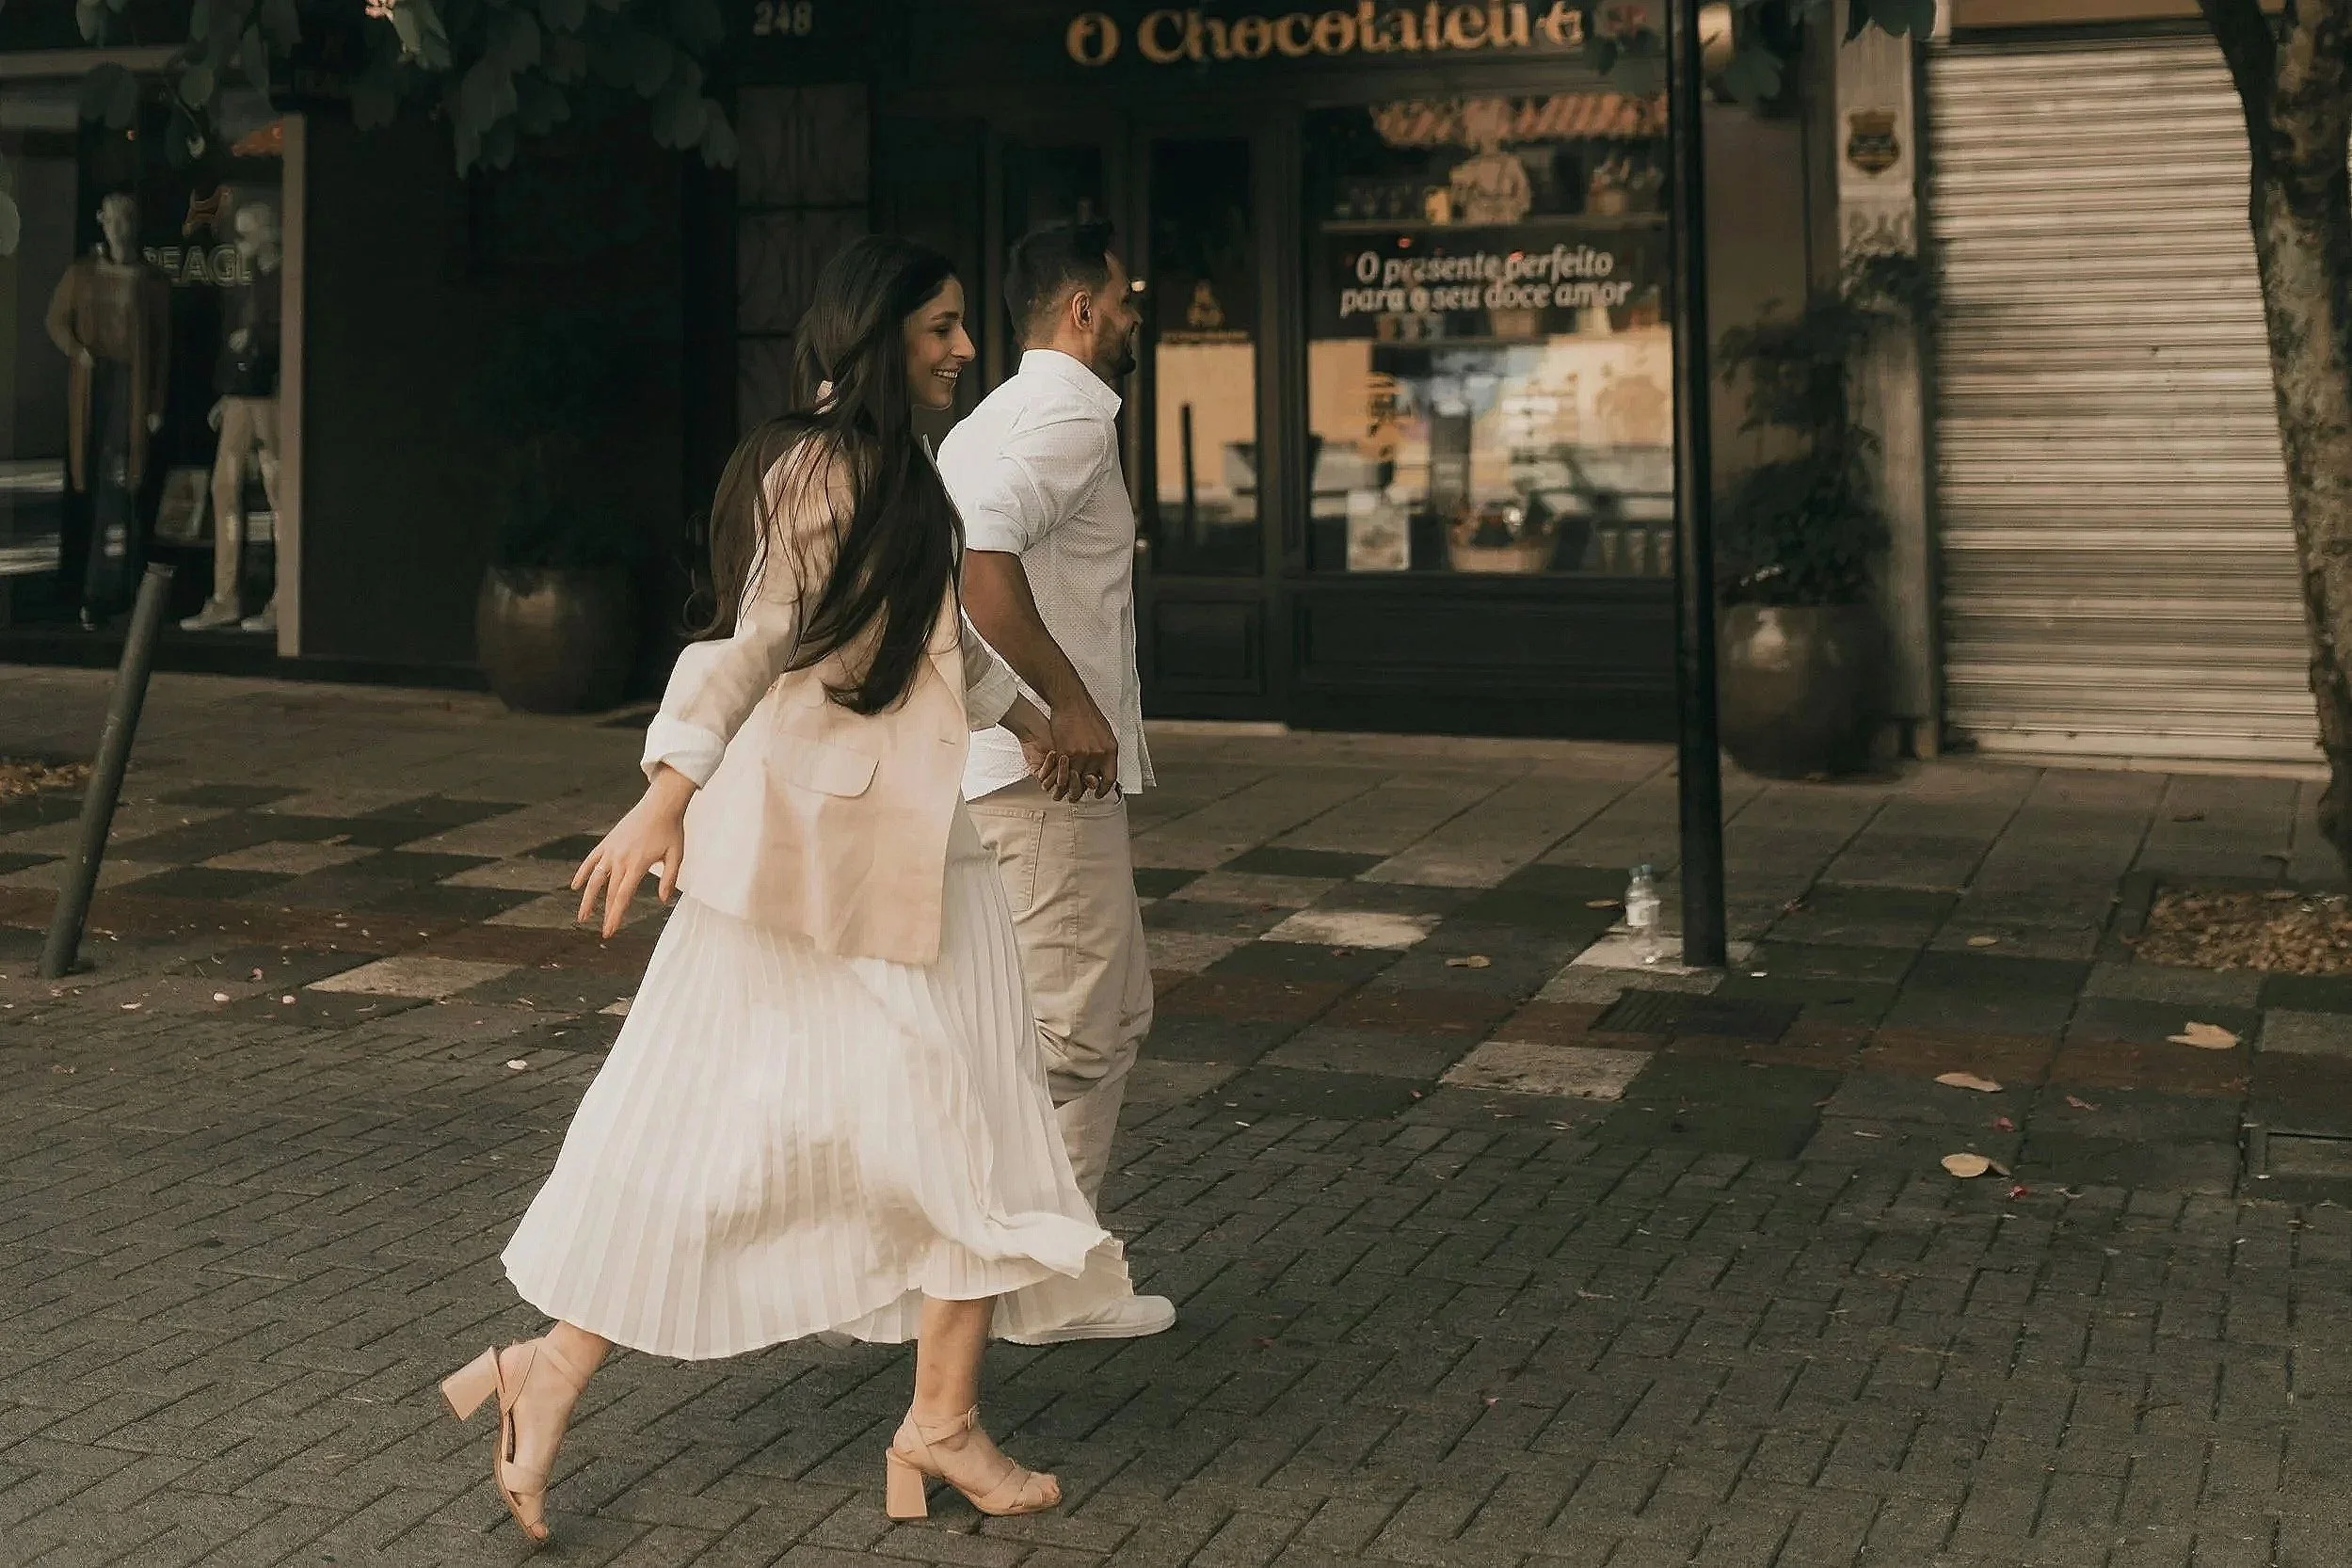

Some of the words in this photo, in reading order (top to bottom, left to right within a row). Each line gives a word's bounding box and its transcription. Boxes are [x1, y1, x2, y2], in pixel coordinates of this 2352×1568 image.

[753, 1, 812, 36] 248
[1066, 11, 1121, 66] O
[1356, 250, 1381, 283] O
[1383, 250, 1502, 287] presente
[1504, 243, 1614, 285] perfeito
[1339, 286, 1406, 318] para
[1410, 287, 1431, 312] o
[1431, 286, 1480, 310] seu
[1484, 278, 1551, 310] doce
[1555, 280, 1633, 309] amor
